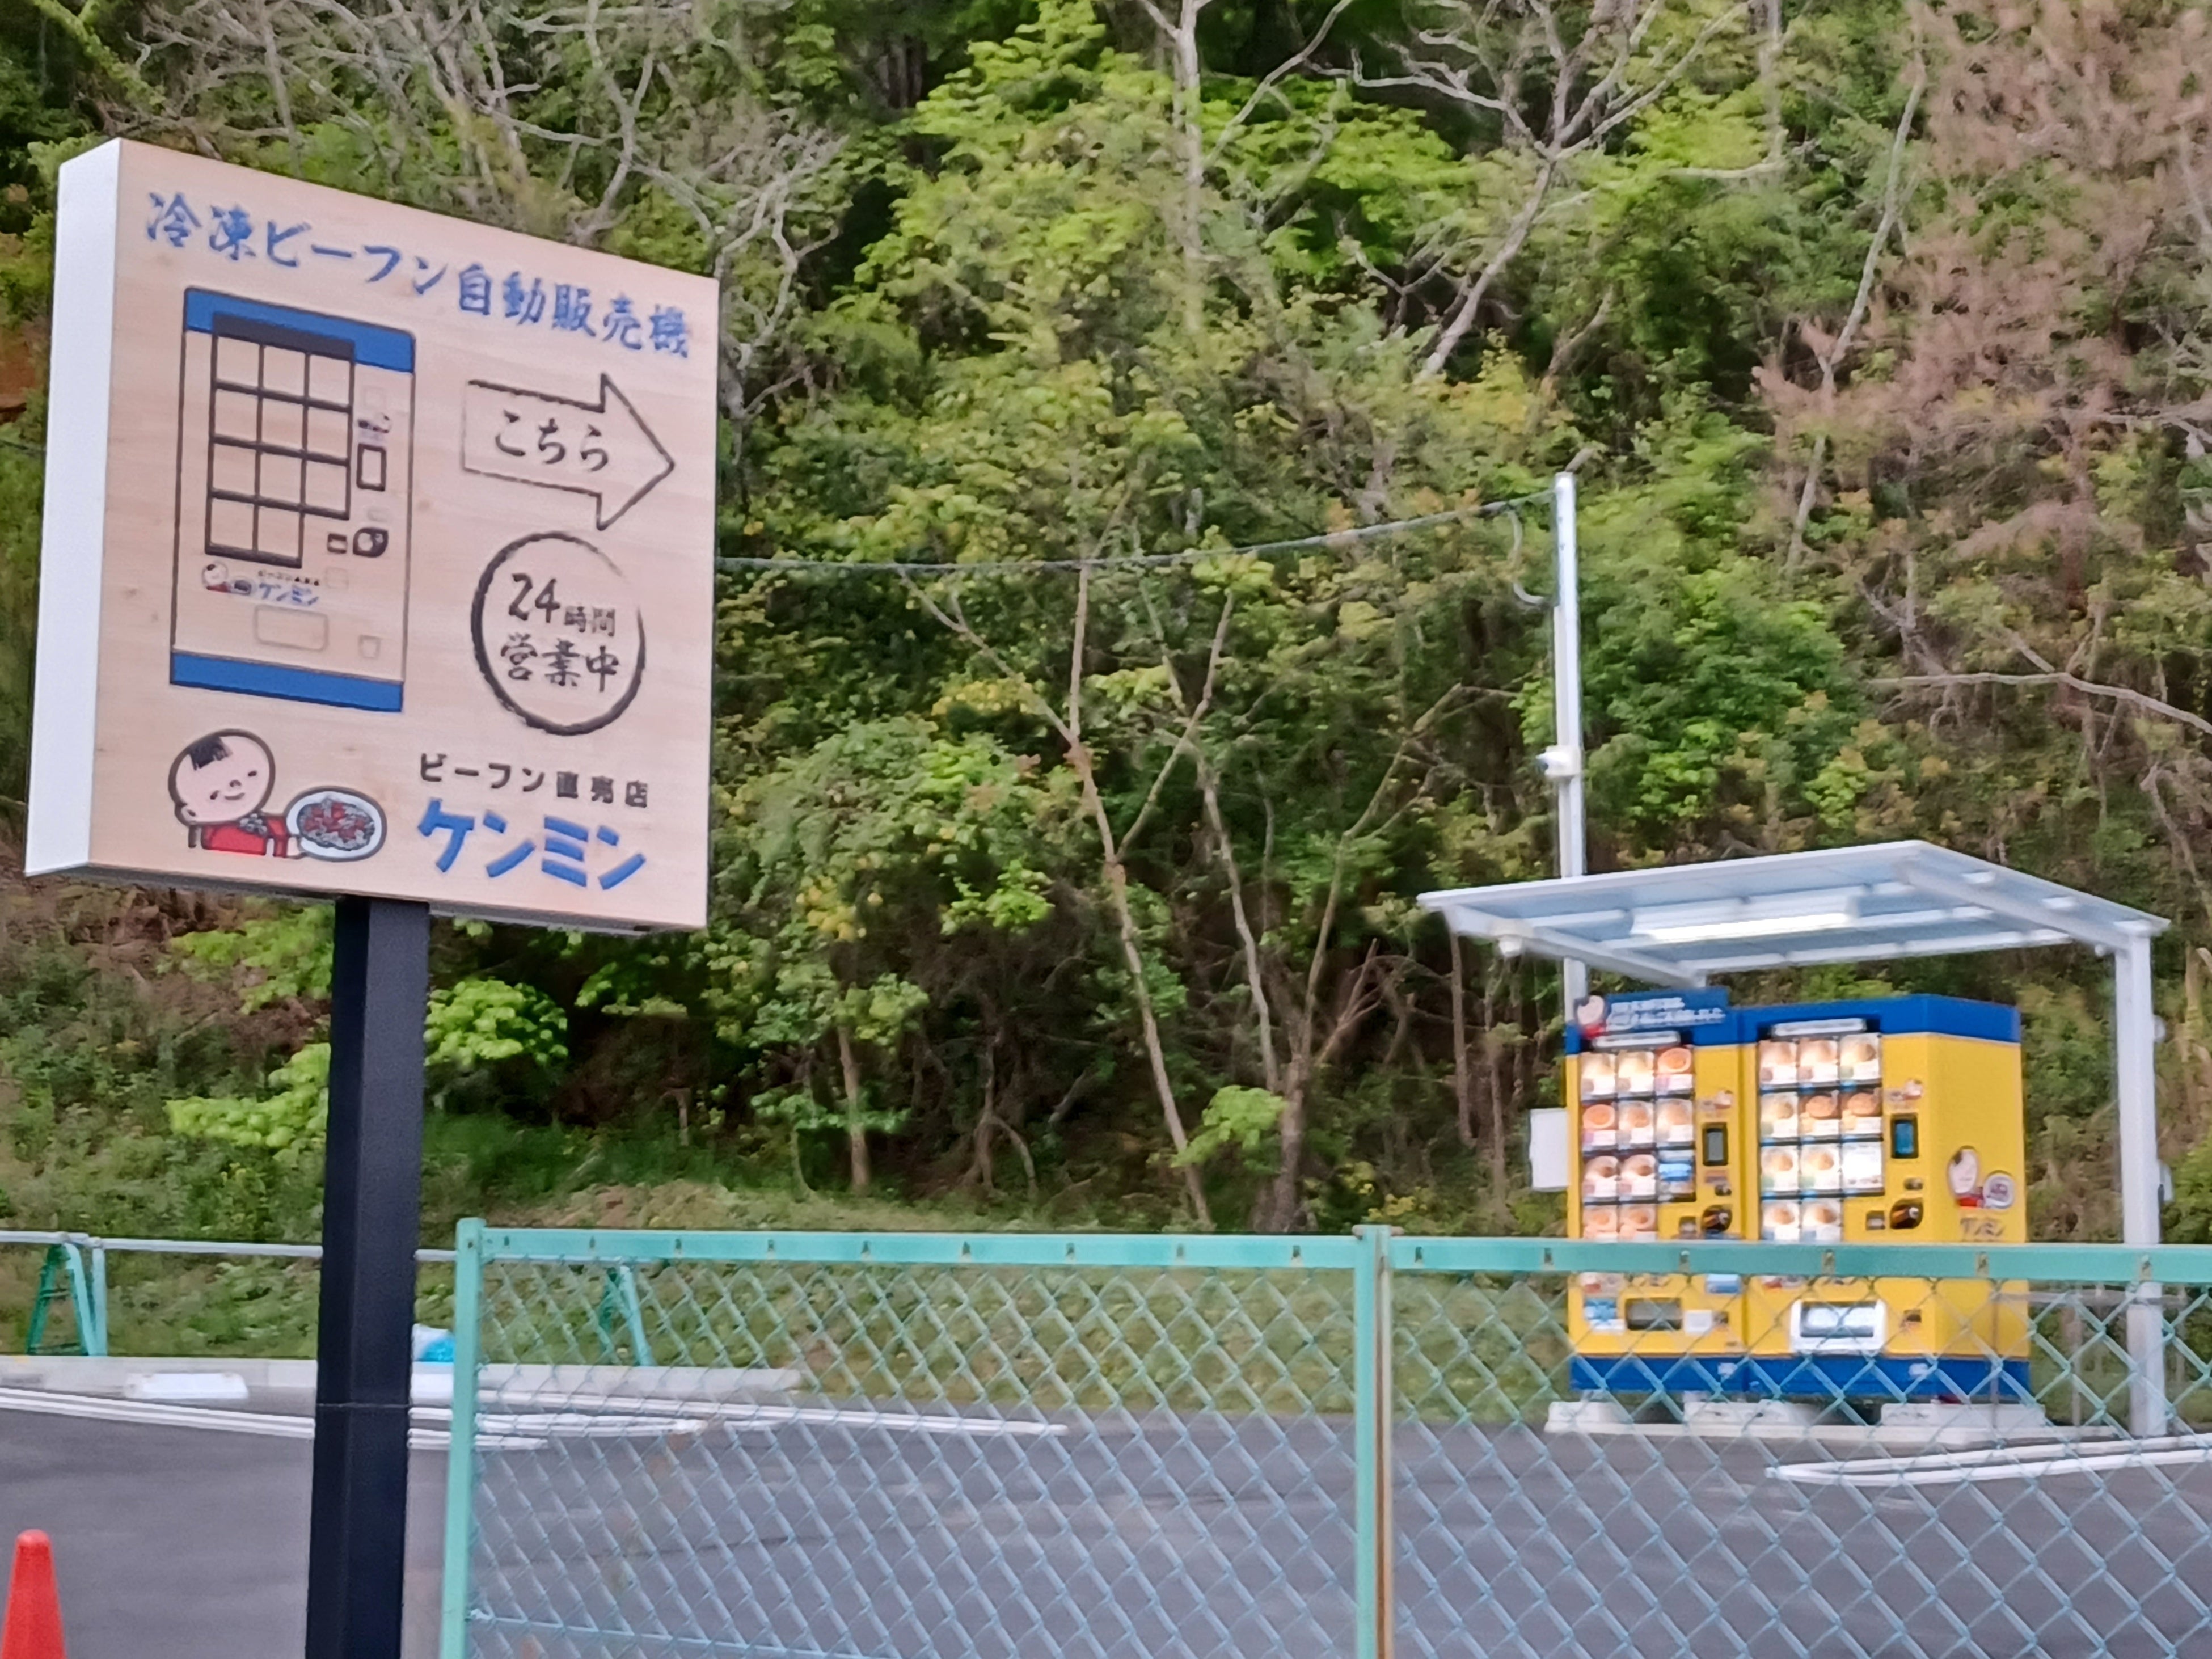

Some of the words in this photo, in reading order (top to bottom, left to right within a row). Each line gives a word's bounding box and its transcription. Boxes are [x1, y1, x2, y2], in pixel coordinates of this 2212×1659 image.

[146, 192, 689, 358] 冷凍ビーフン自動販売機
[495, 409, 609, 472] こちら
[508, 573, 616, 637] 24時間
[500, 632, 619, 693] 営業中
[417, 797, 647, 890] ケンミン
